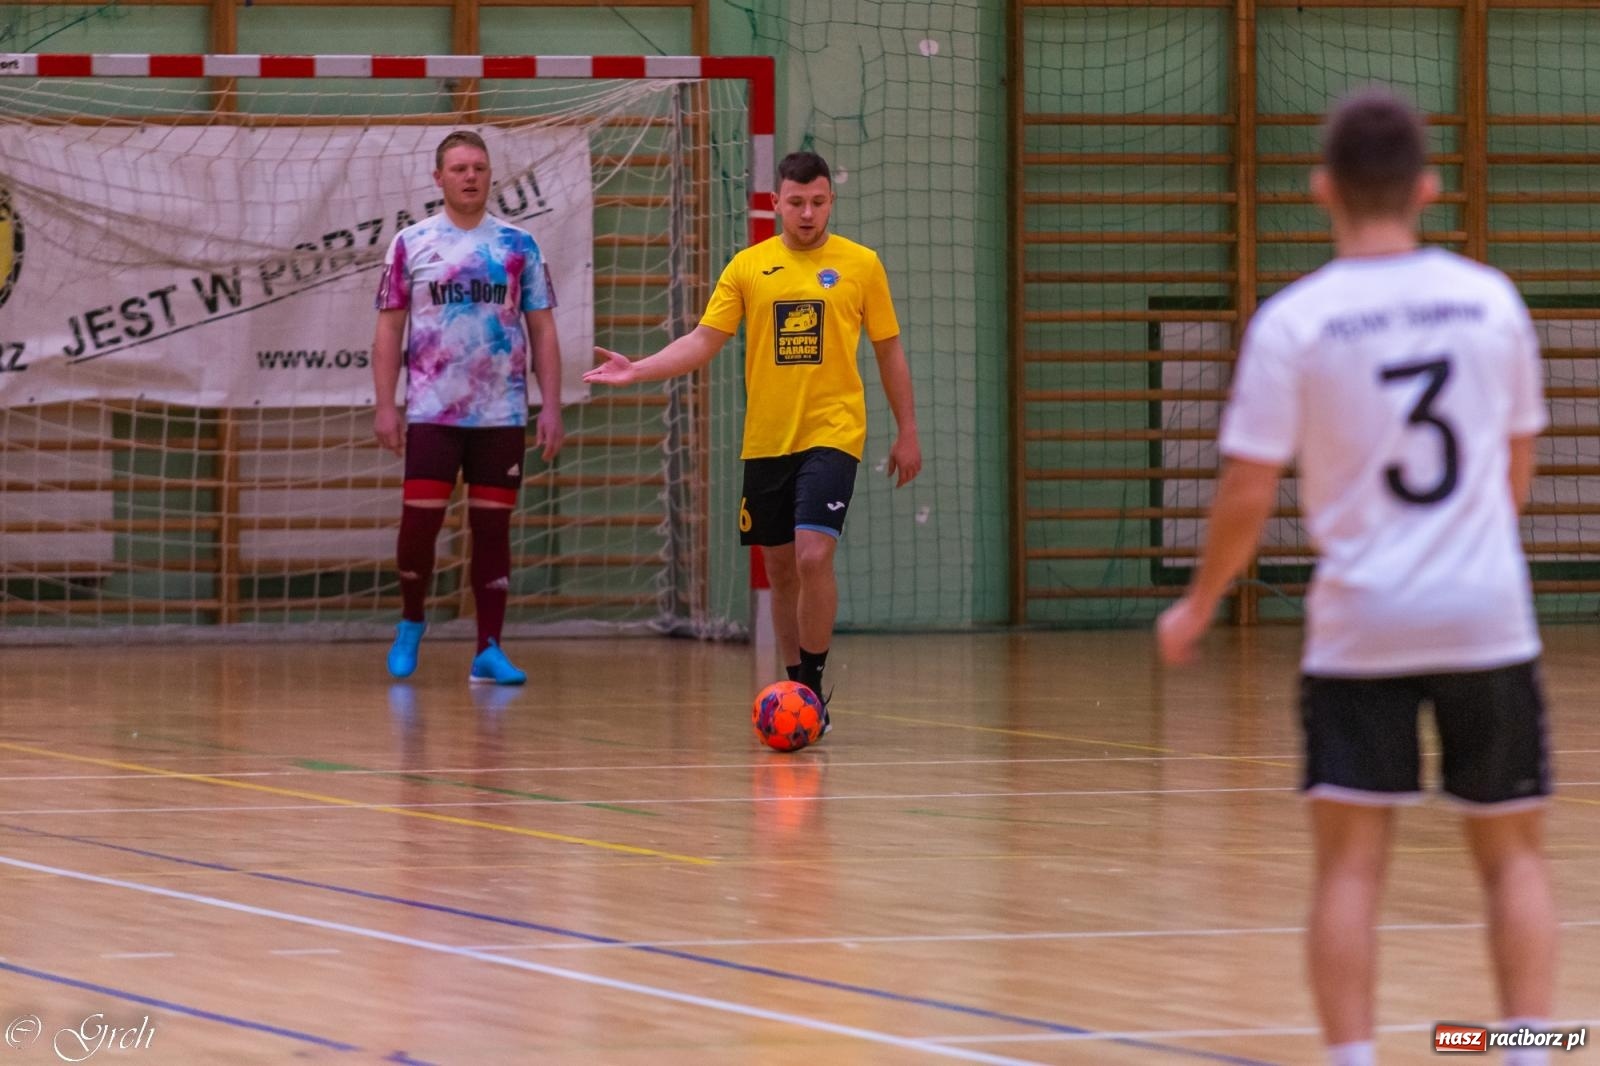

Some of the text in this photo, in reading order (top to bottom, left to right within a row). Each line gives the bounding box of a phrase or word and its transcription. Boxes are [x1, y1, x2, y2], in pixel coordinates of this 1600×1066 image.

[0, 59, 20, 70] ort
[428, 278, 508, 306] Kris-Dom
[62, 284, 178, 357] JEST
[191, 264, 242, 315] W
[778, 345, 818, 356] GARAGE
[1379, 354, 1460, 506] 3
